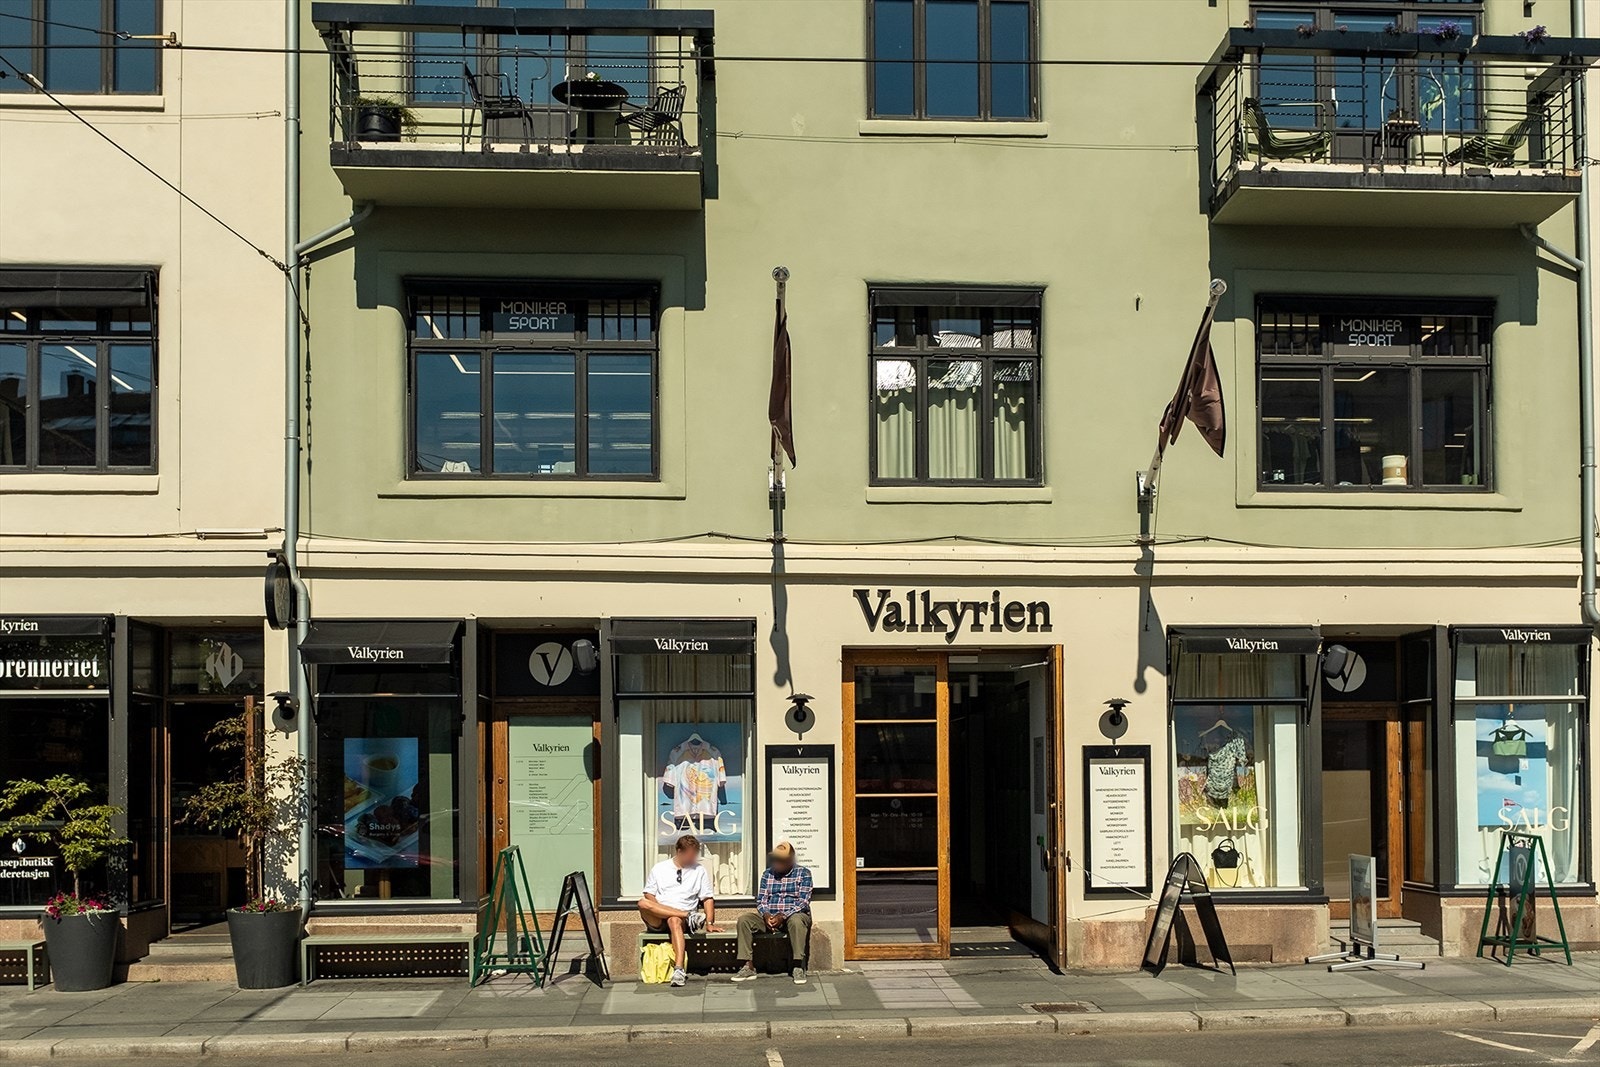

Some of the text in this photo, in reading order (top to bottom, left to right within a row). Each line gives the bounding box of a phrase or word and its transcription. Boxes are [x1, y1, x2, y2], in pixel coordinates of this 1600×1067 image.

[500, 301, 567, 315] MONIKER
[509, 316, 559, 330] SPORT
[1340, 319, 1403, 332] MONIKER
[1348, 333, 1395, 347] SPORT
[852, 589, 1053, 644] Valkyrien
[1500, 629, 1551, 643] Valkyrien
[653, 638, 708, 653] Valkyrien
[1225, 638, 1279, 653] Valkyrien
[347, 646, 404, 662] Valkyrien
[532, 743, 570, 755] Valkyrien
[782, 766, 820, 776] Valkyrien
[1099, 767, 1136, 778] Valkyrien
[660, 809, 737, 836] SALG
[1194, 805, 1269, 832] SALG
[1497, 806, 1570, 832] SALG
[368, 822, 401, 832] Shadys
